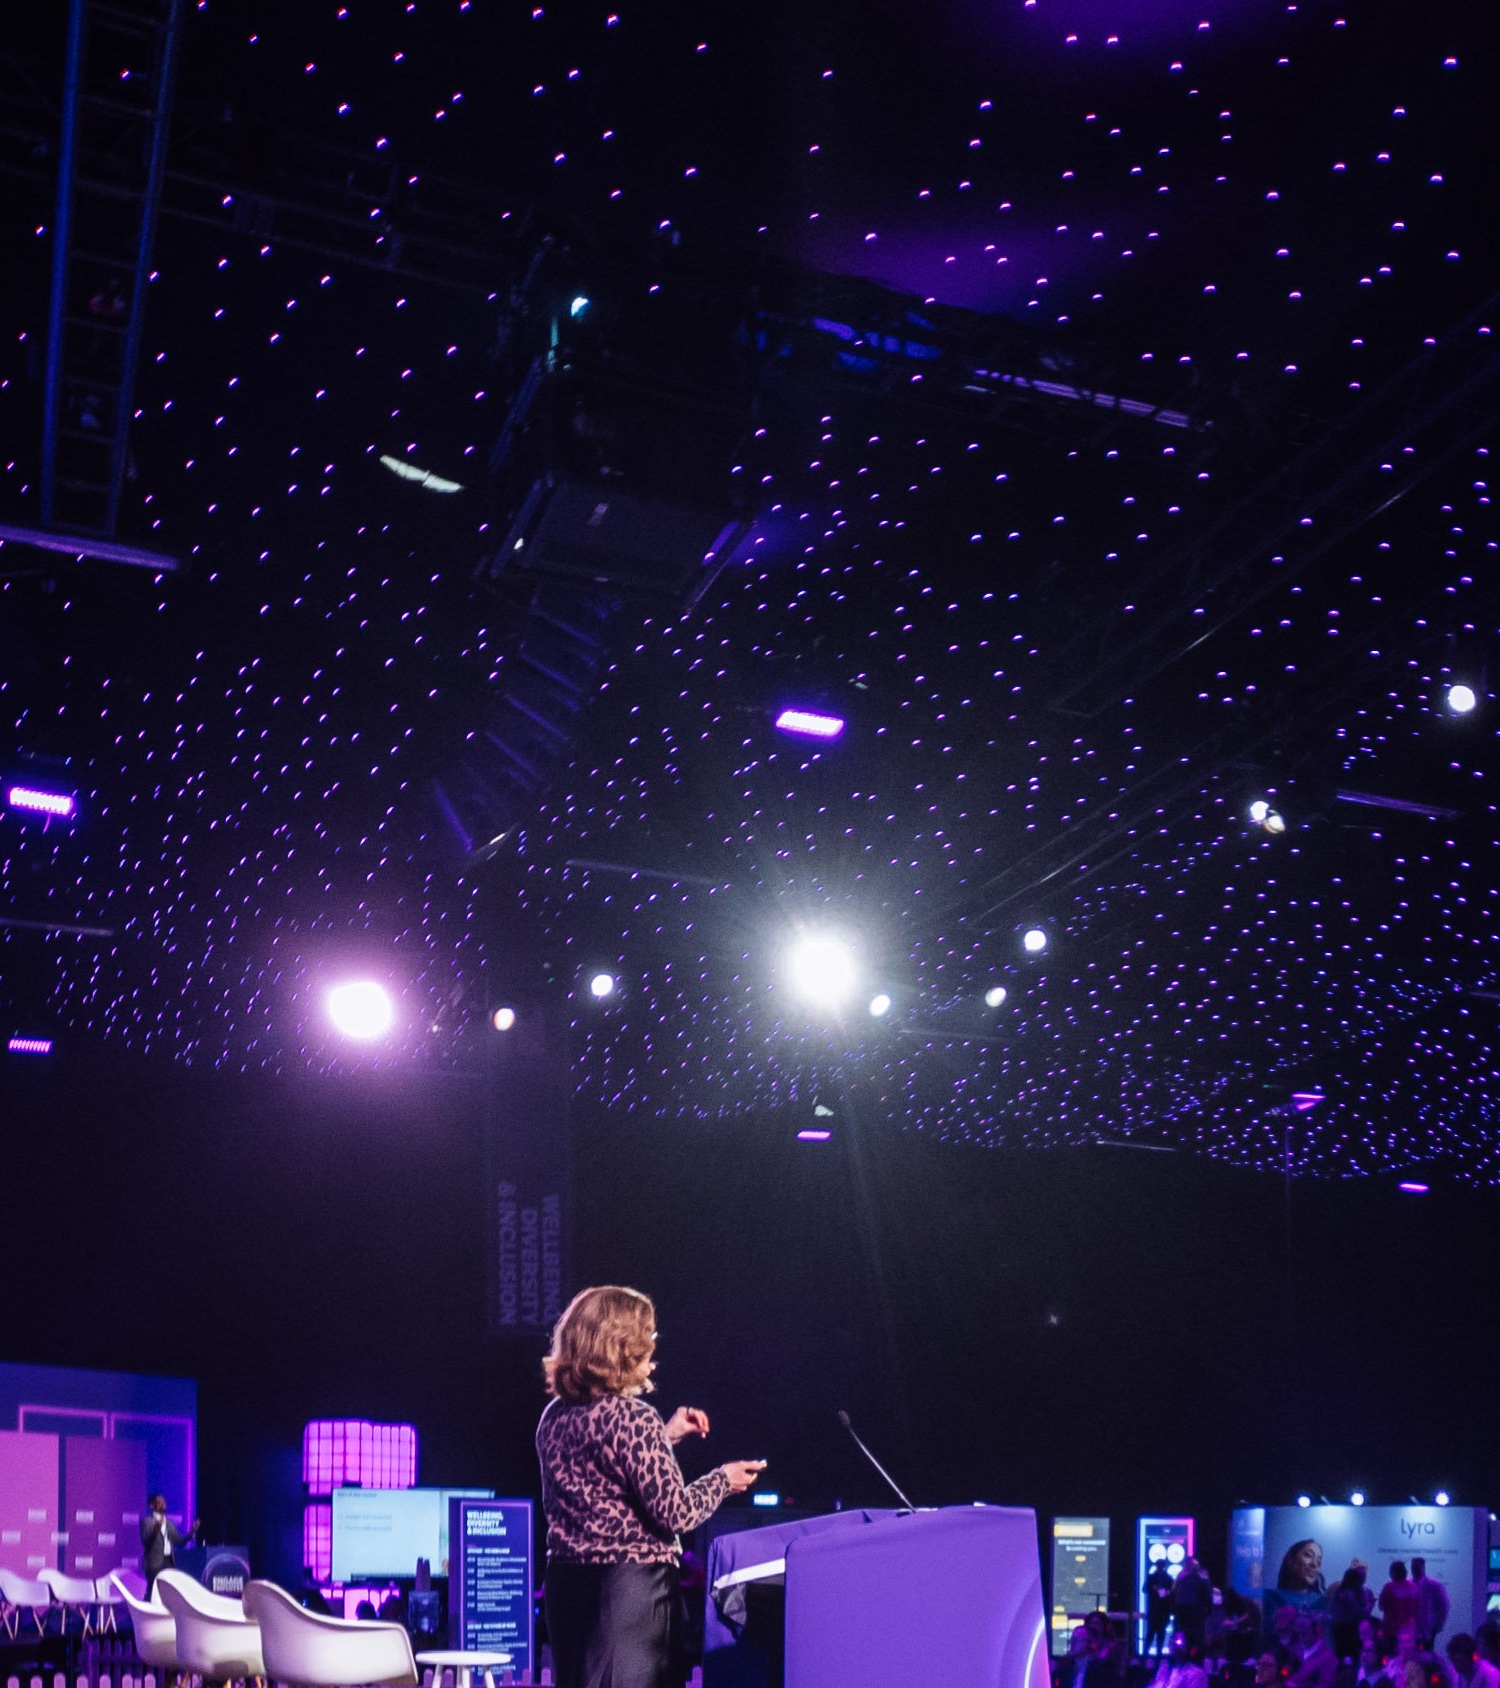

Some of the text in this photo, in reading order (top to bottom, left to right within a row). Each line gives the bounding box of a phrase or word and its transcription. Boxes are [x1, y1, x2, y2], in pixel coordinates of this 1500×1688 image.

[499, 1202, 517, 1325] INCLUSION
[520, 1207, 539, 1325] DIVERSITY
[1400, 1518, 1436, 1538] lyra
